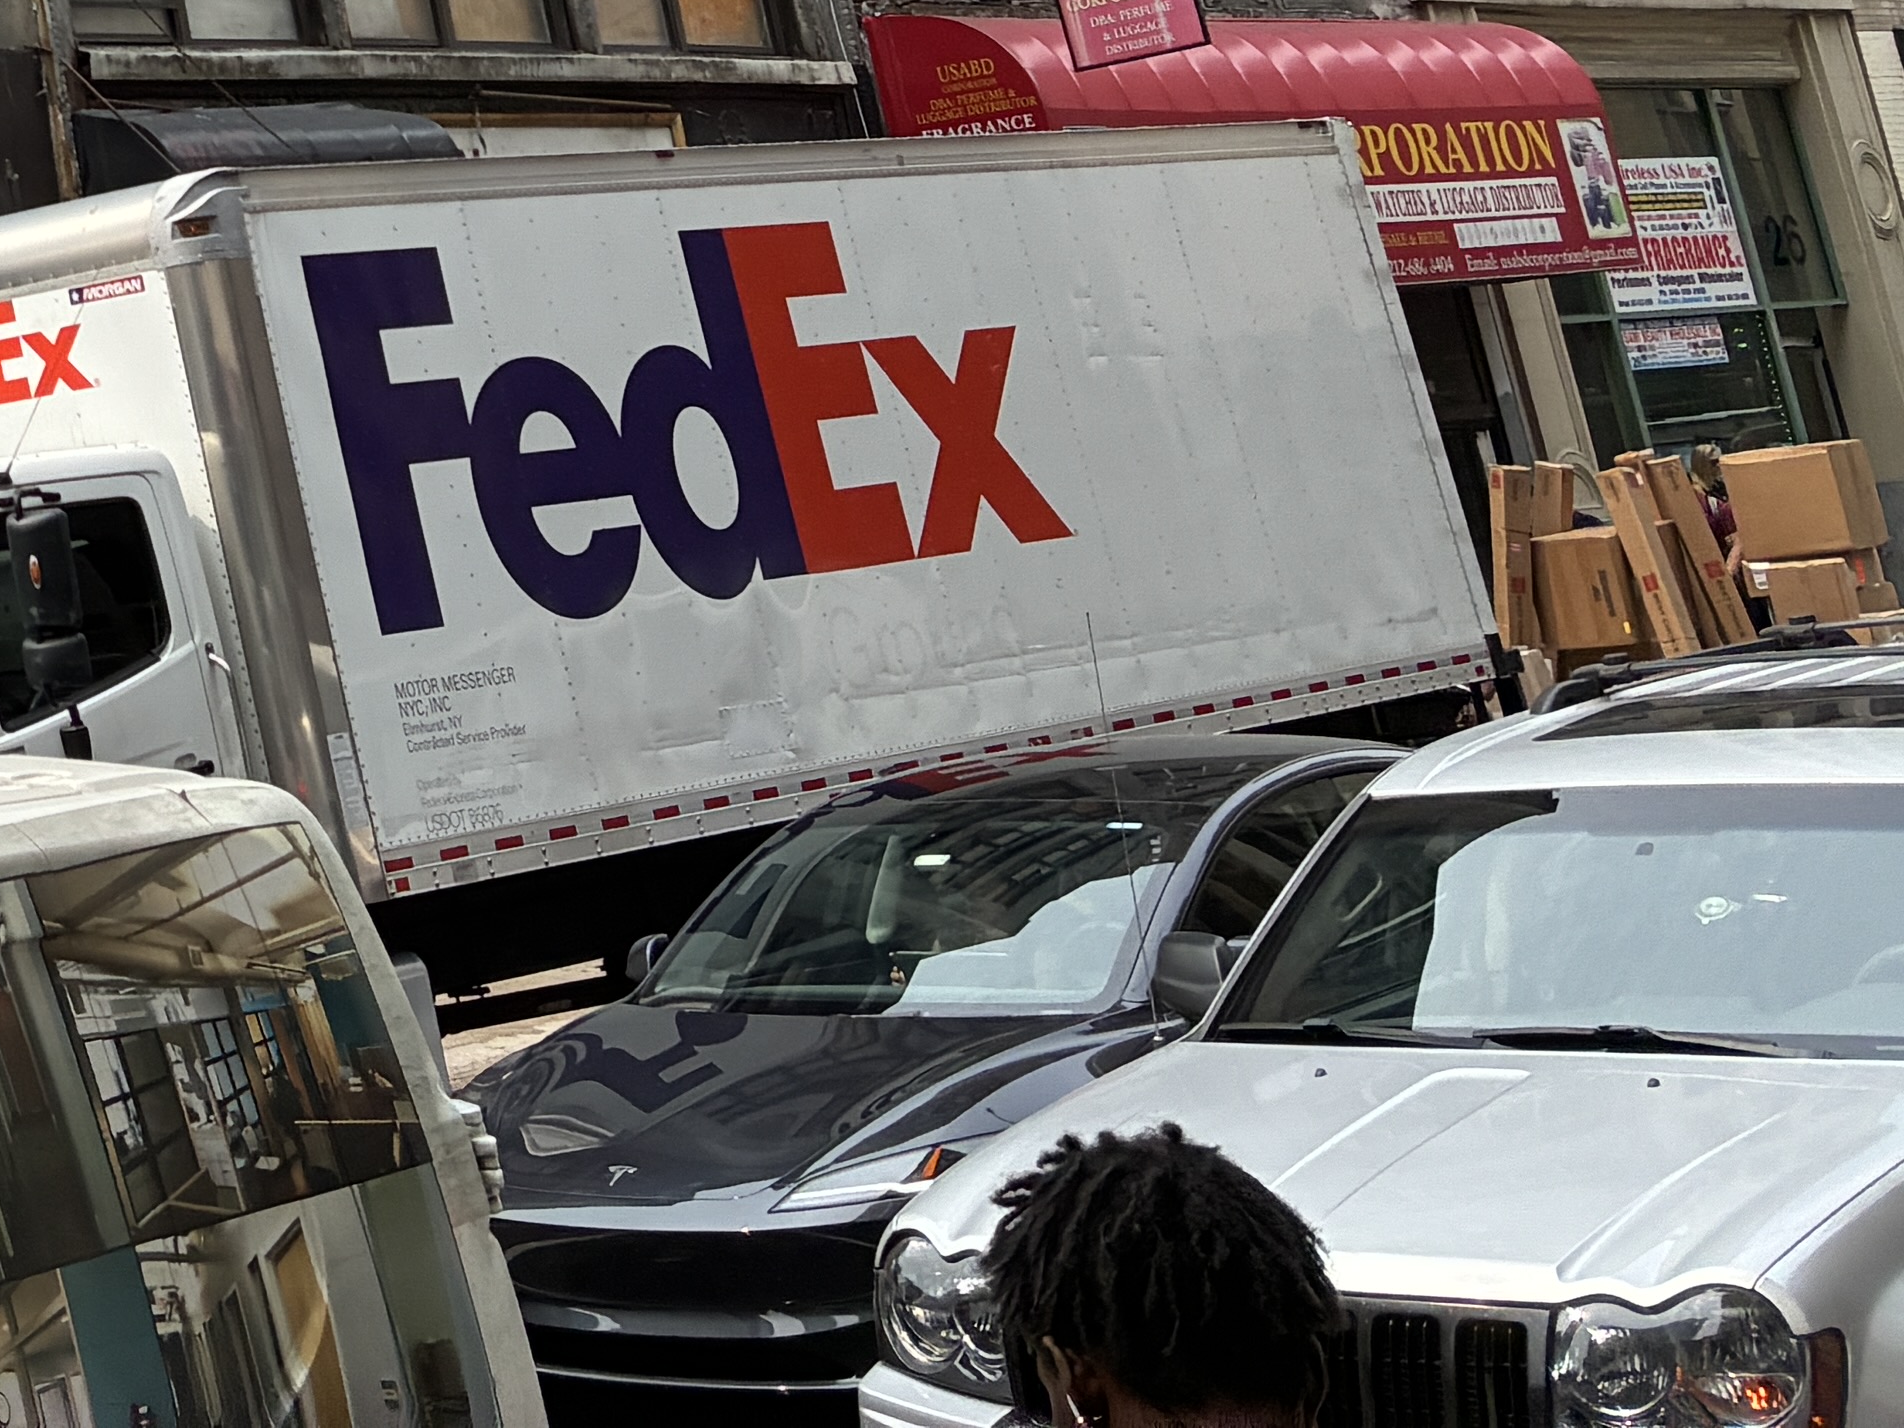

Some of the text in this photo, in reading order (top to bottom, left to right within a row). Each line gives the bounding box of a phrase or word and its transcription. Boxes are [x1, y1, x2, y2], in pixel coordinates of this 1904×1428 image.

[936, 57, 995, 83] USABD
[921, 113, 1036, 138] FRAGRANCE
[1371, 183, 1563, 218] WATCHES & LUGGAGE DISTRIBUTOR
[82, 276, 144, 302] MORGAN
[301, 220, 1076, 635] FedEx
[394, 666, 517, 700] MOTOR MESSENGER
[429, 695, 452, 713] INC
[448, 714, 463, 730] NY
[456, 729, 490, 746] Service
[490, 722, 527, 741] Provider
[425, 808, 467, 833] USDOT
